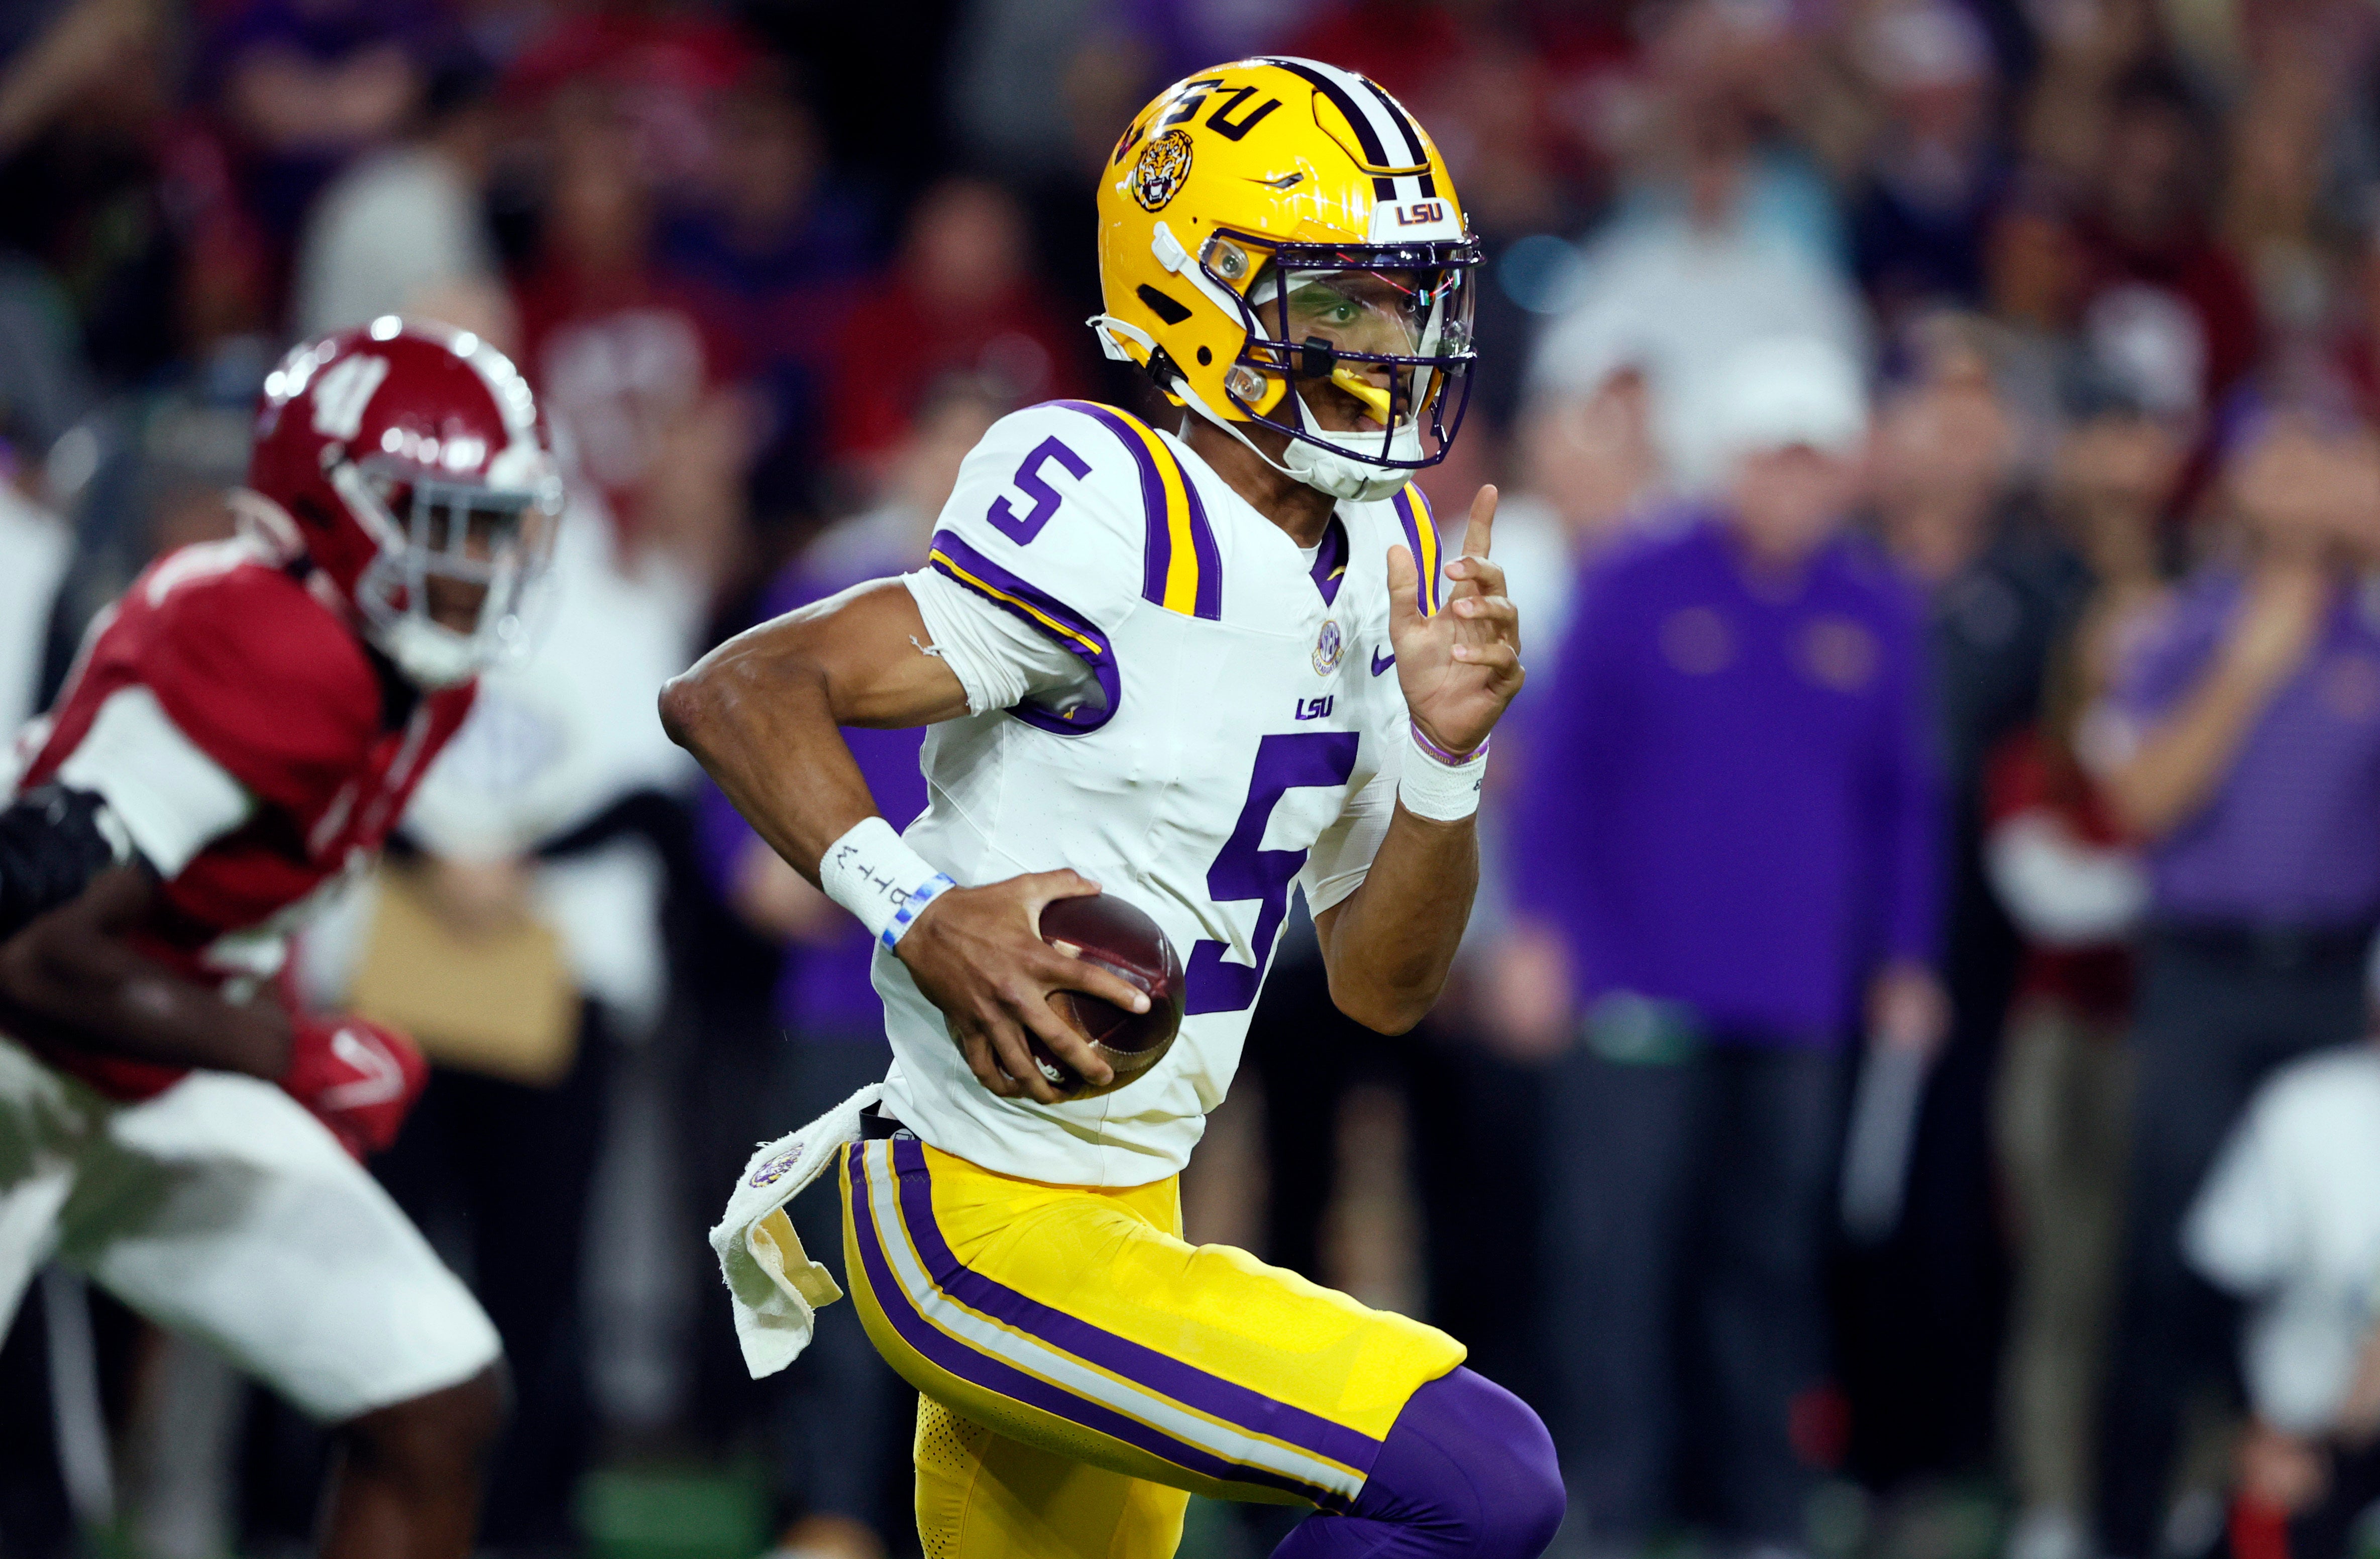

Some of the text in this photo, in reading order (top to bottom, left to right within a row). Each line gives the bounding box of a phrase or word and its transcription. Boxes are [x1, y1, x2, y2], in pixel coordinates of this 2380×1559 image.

[1114, 78, 1283, 166] LSU
[1394, 202, 1444, 227] LSU
[986, 434, 1093, 547] 5
[1294, 695, 1334, 720] LSU
[1412, 730, 1450, 764] Thompson
[1183, 731, 1360, 1016] 5
